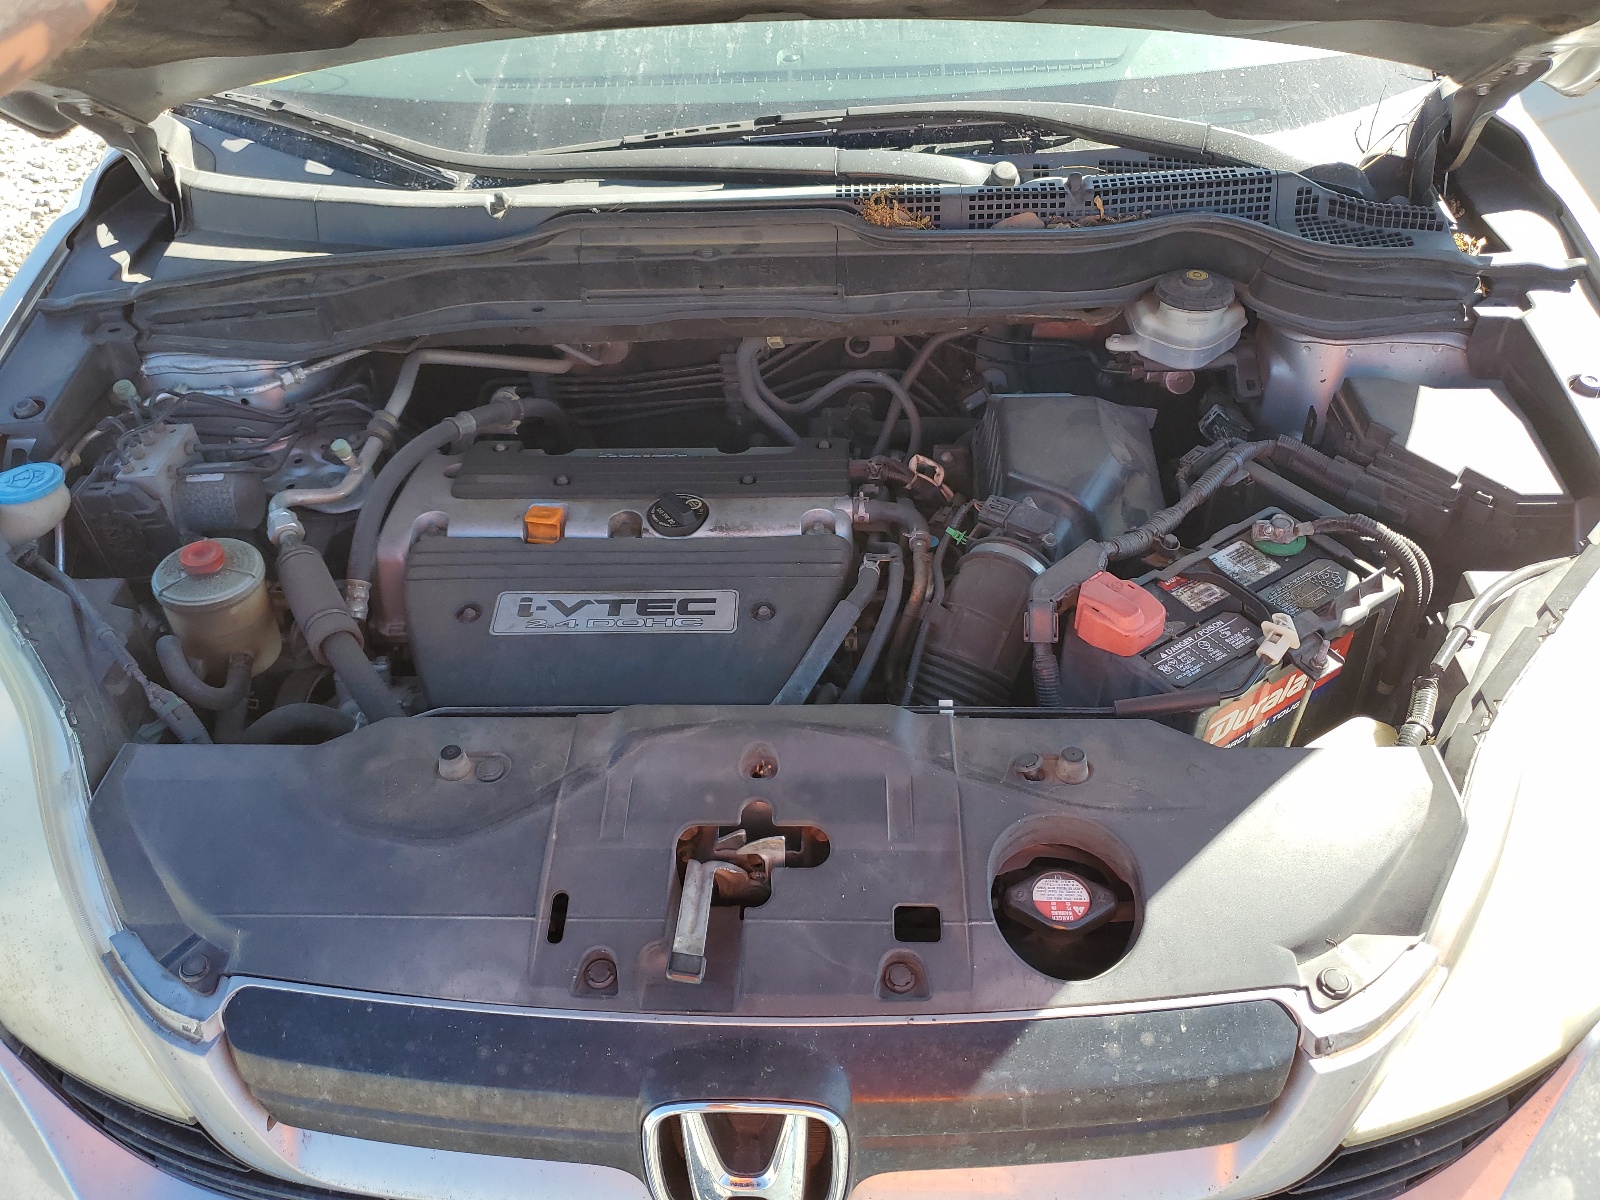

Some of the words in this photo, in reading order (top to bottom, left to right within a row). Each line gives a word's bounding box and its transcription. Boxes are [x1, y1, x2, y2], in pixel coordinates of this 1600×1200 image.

[517, 596, 716, 617] i-VTEC
[525, 618, 579, 628] 2.4
[586, 617, 703, 628] DOHC
[1165, 635, 1195, 656] DANGER
[1198, 620, 1225, 637] POISON
[1209, 672, 1309, 745] Durala
[1272, 700, 1301, 722] TOUG
